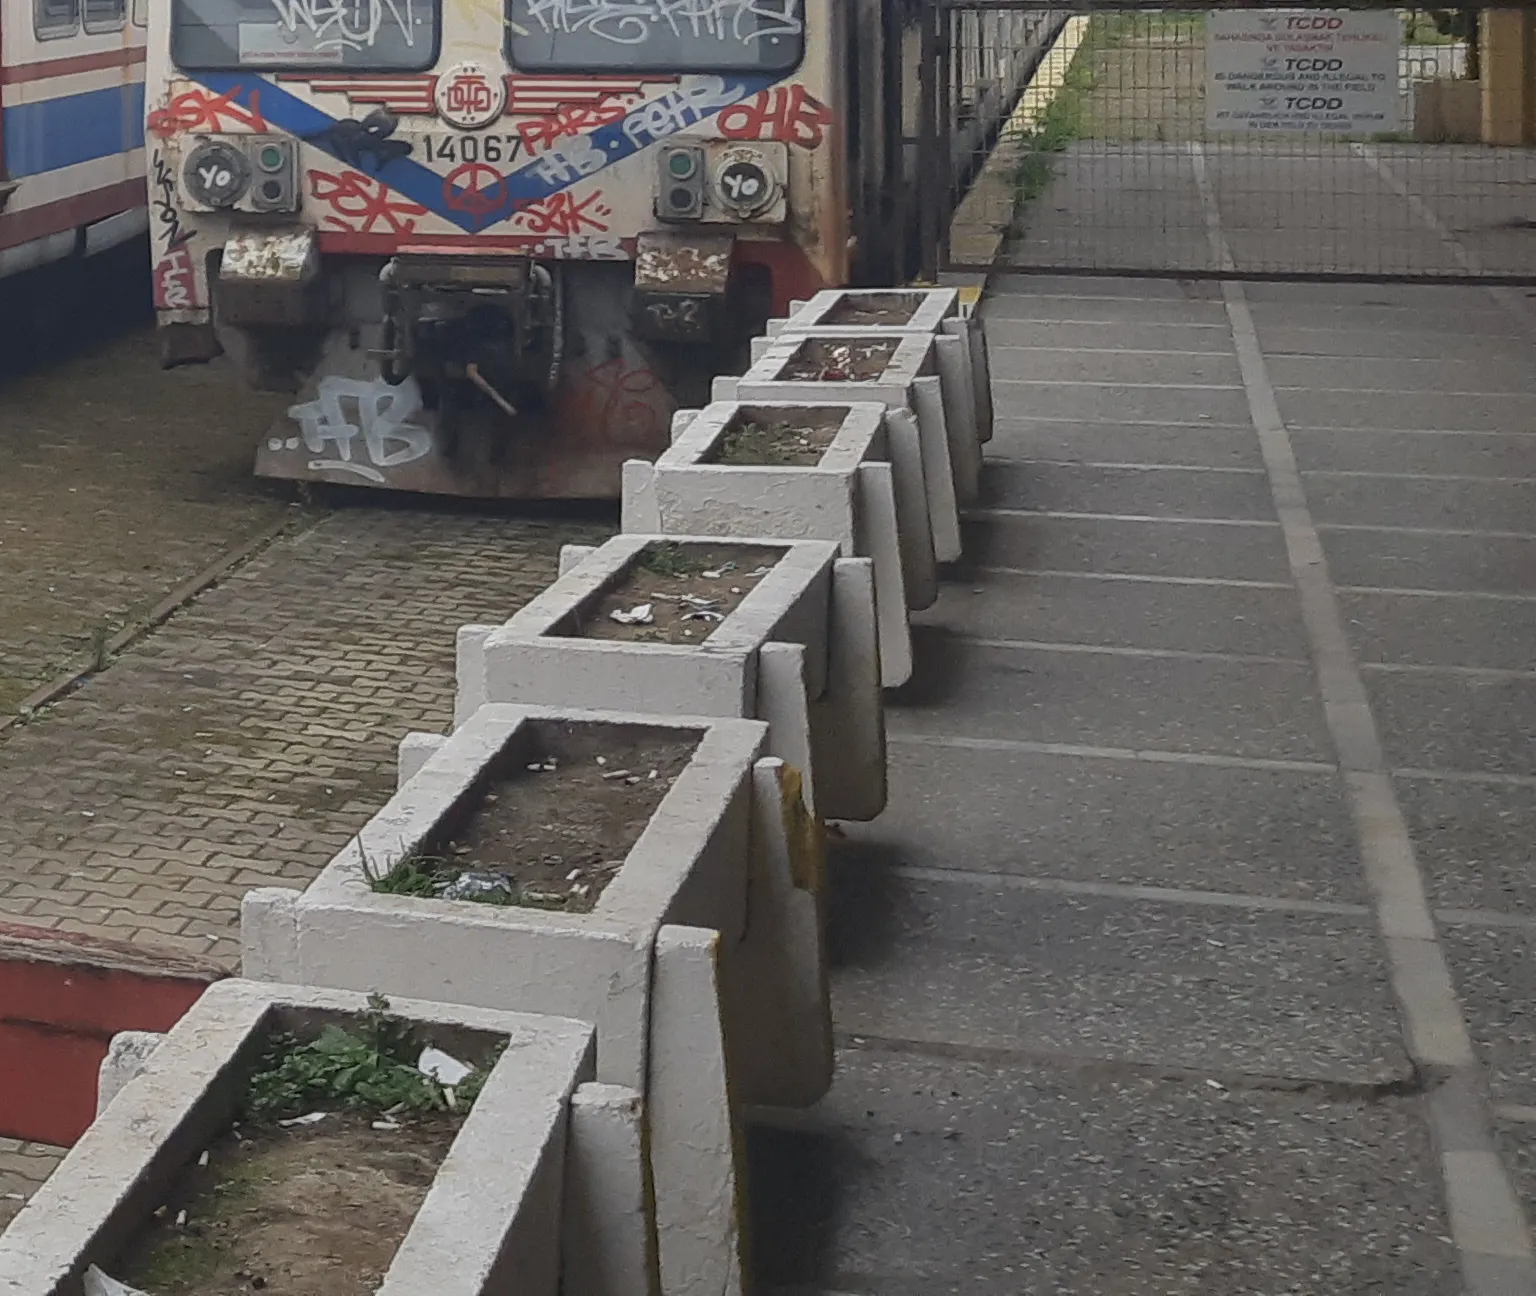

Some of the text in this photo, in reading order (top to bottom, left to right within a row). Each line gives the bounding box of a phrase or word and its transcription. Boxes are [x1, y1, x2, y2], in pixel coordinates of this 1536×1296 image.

[1286, 16, 1343, 30] TCDD
[1285, 58, 1343, 71] TCDD
[1371, 73, 1386, 81] TO
[1285, 97, 1343, 110] TCDD
[423, 134, 522, 163] 14067
